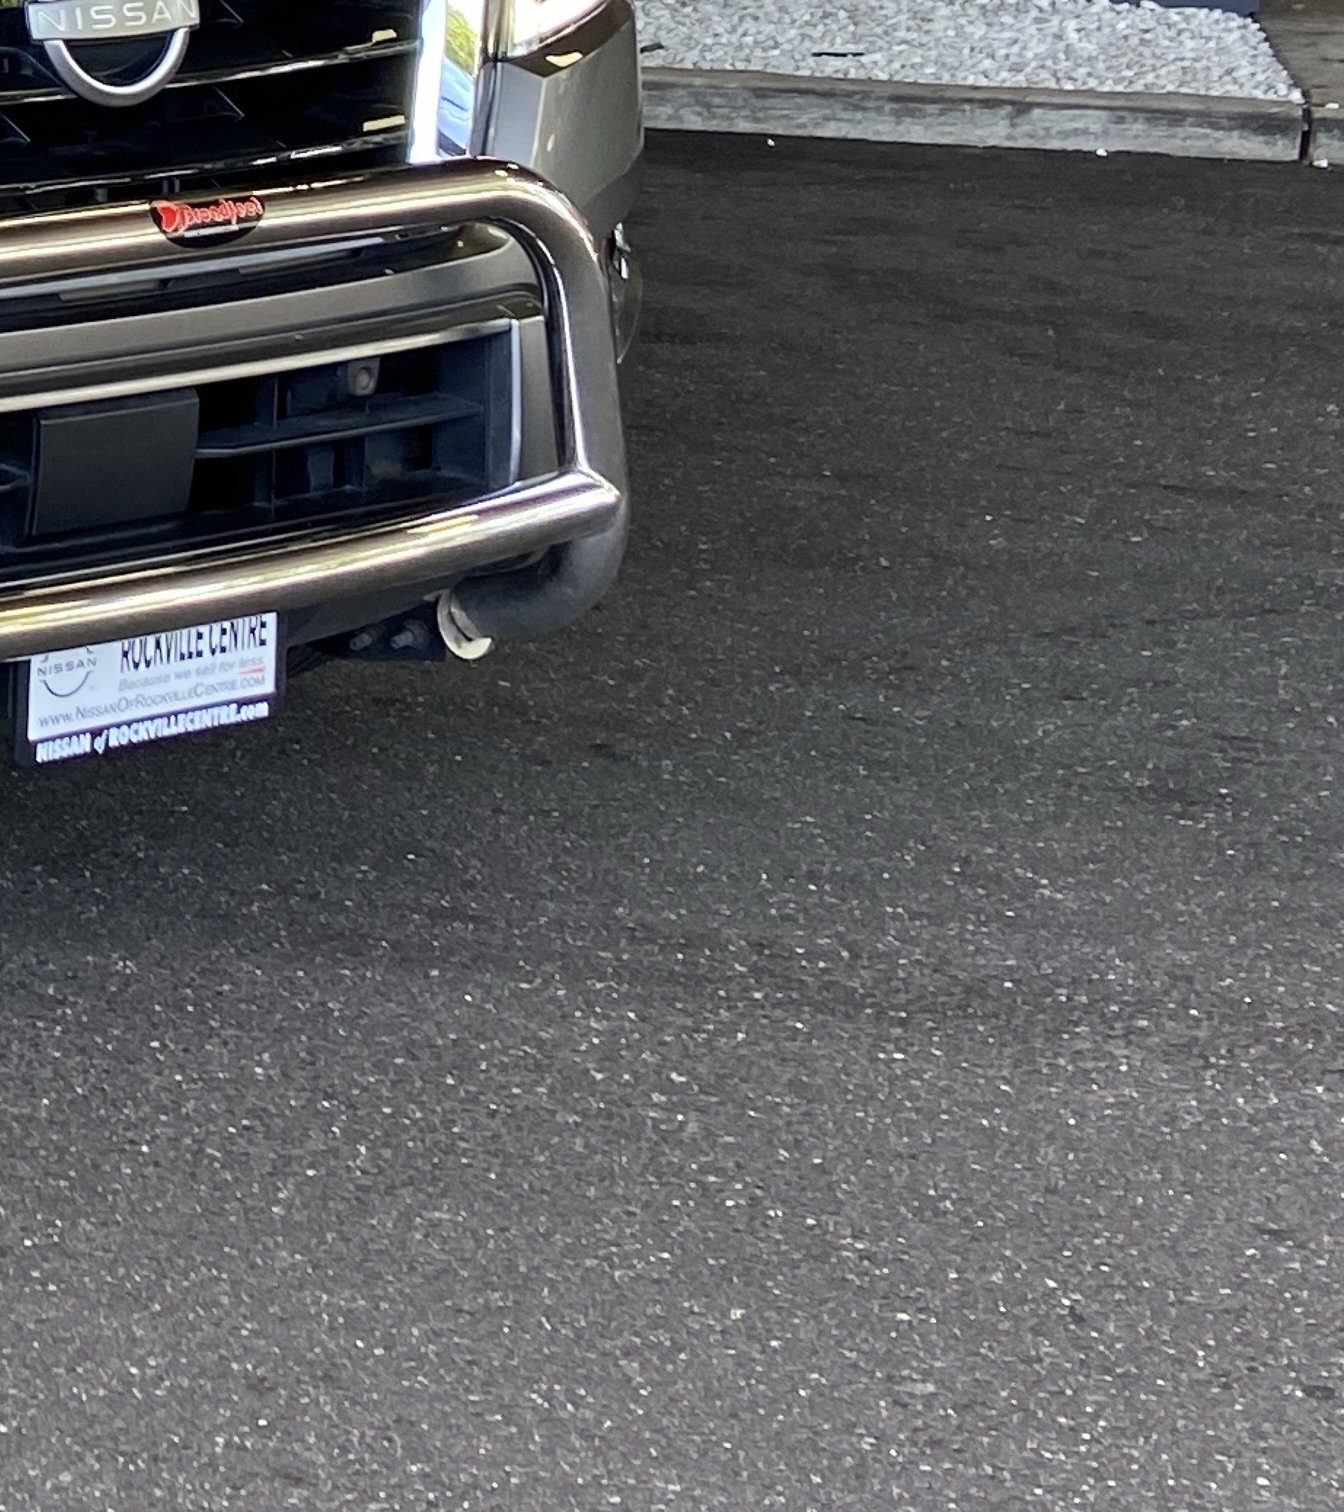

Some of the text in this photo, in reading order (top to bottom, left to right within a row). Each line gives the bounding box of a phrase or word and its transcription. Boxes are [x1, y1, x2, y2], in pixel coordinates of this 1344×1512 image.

[120, 615, 267, 674] ROCKVILLE CENTRE
[37, 656, 97, 677] NISSAN
[35, 733, 92, 764] NISSAN
